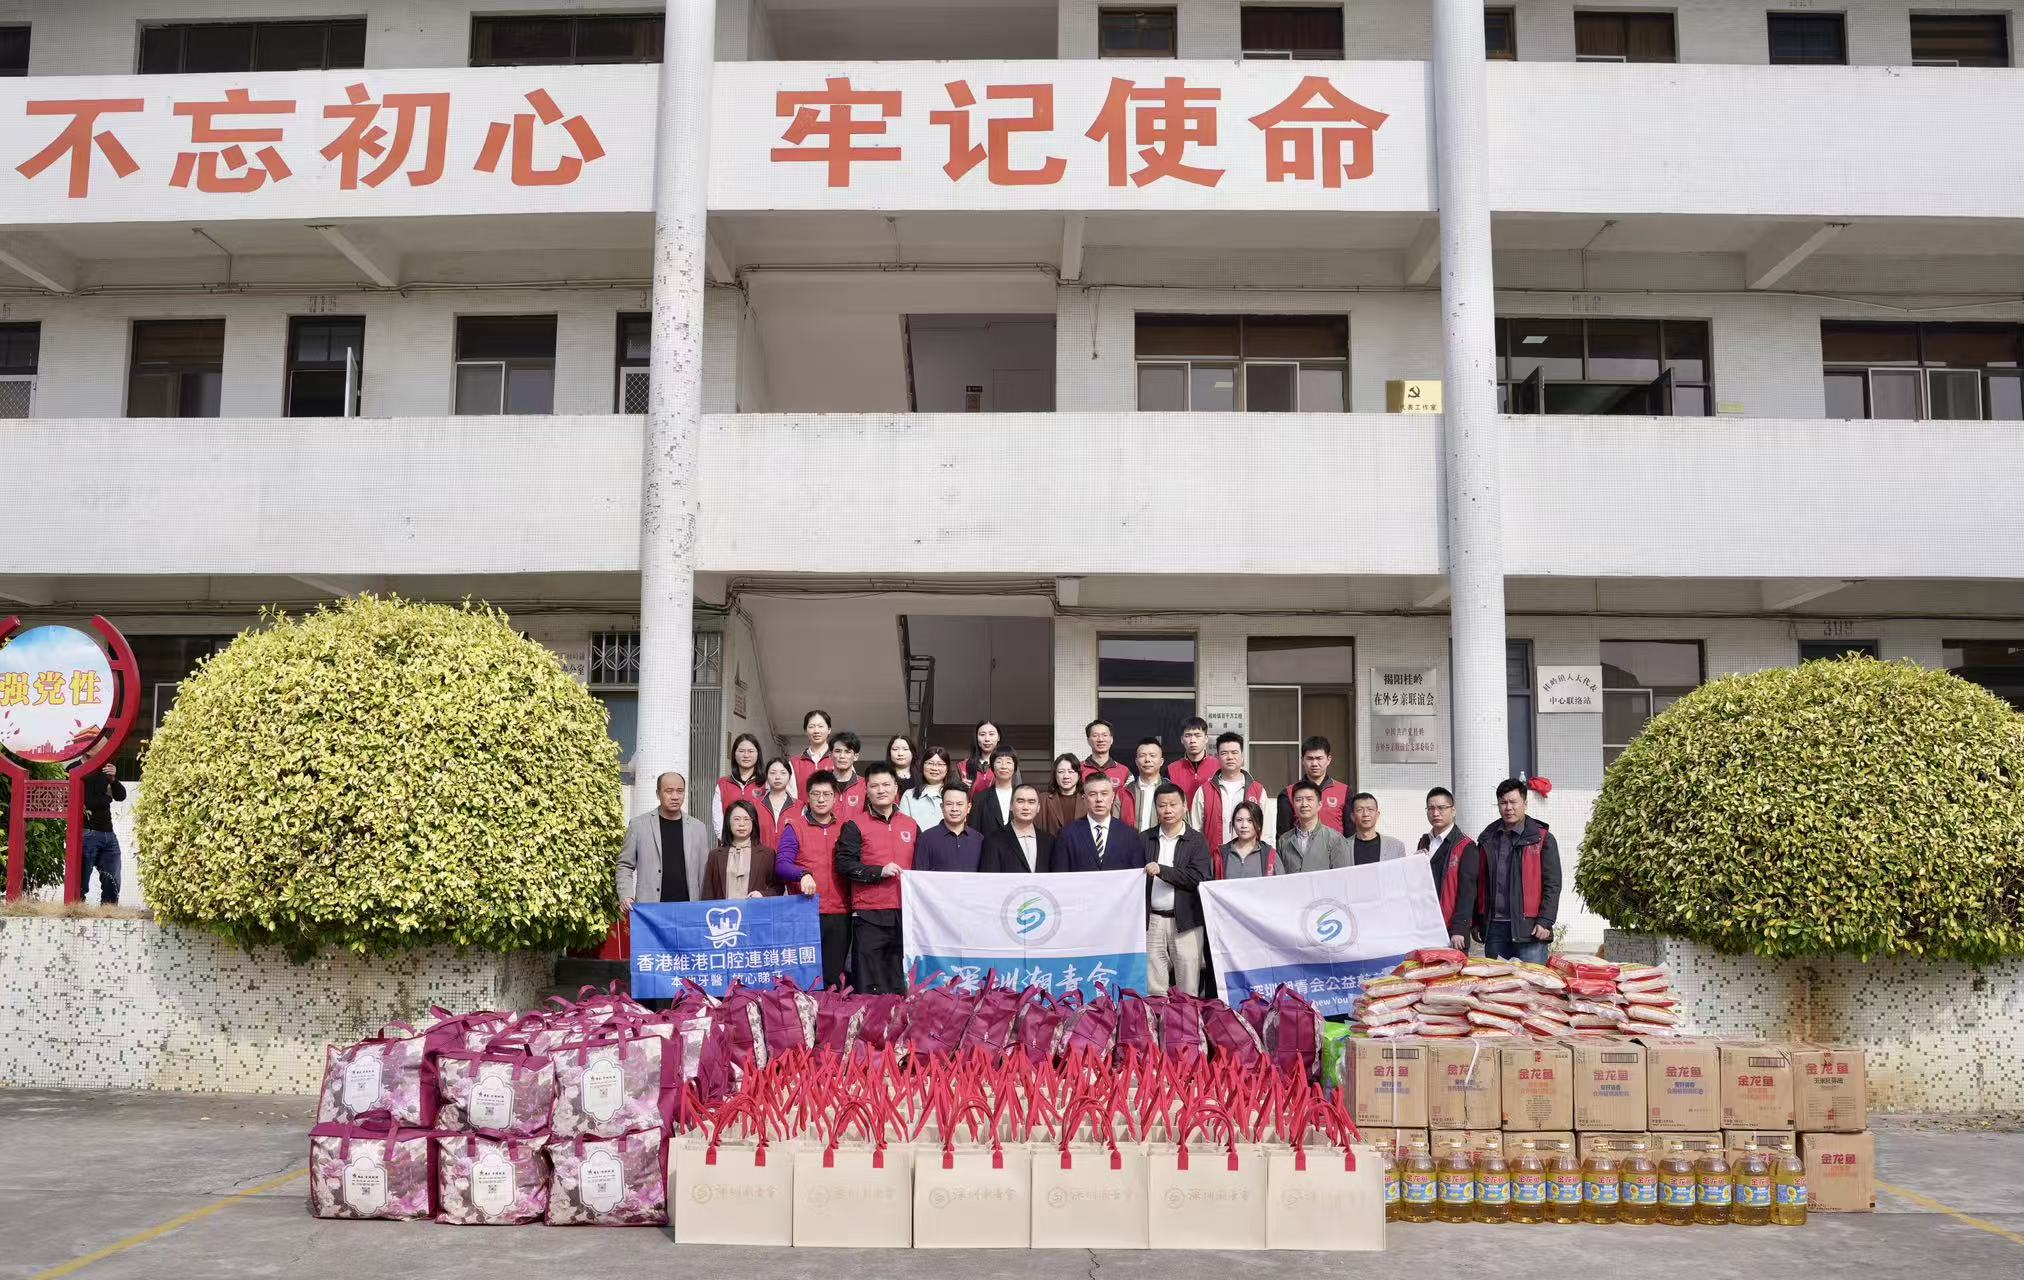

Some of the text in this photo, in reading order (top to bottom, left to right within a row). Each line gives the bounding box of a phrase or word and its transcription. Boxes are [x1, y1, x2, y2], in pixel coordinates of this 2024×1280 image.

[15, 76, 1390, 198] 不忘初心 牢记使命
[1384, 673, 1423, 685] 揭阳桂岭
[0, 670, 102, 706] 强党性
[1374, 692, 1434, 706] 在外乡亲联谊会
[1549, 696, 1591, 705] 中心联络站
[636, 946, 816, 972] 香港維港口腔連鎖集團
[1519, 1068, 1555, 1080] 金龙鱼
[1593, 1069, 1629, 1081] 金龙鱼
[1665, 1066, 1703, 1078] 金龙鱼
[1737, 1075, 1775, 1087] 金龙鱼
[1821, 1153, 1857, 1165] 金龙鱼
